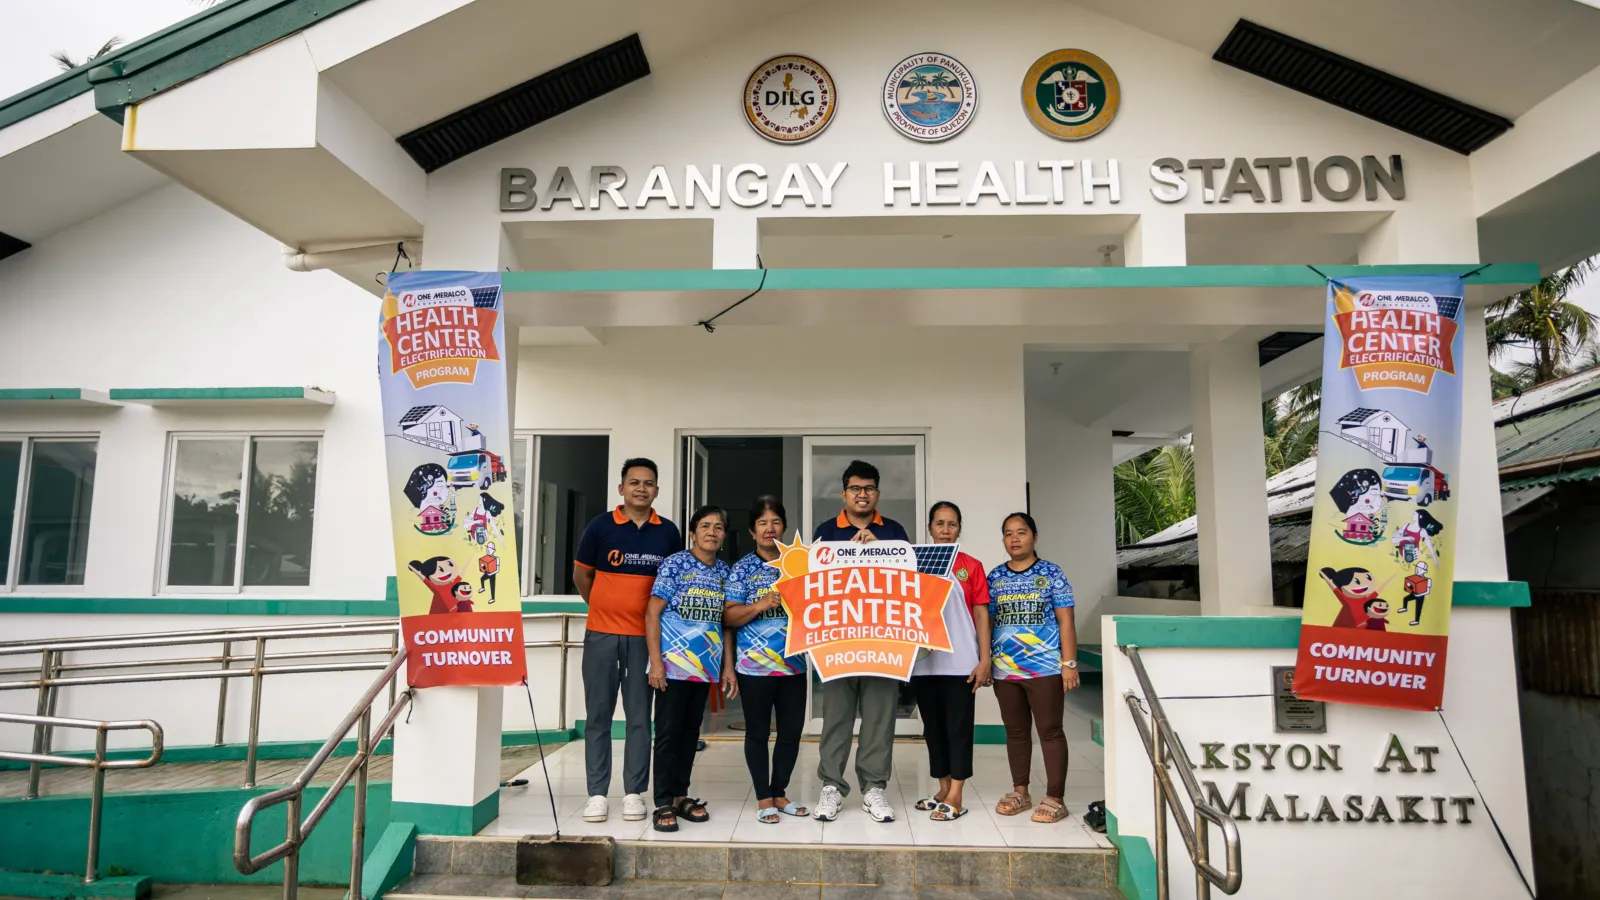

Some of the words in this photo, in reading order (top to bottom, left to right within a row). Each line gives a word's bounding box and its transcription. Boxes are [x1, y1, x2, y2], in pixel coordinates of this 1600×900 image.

[887, 57, 924, 99] MUNICIPALITY
[940, 58, 972, 99] PANUKULAN
[765, 91, 815, 106] DILG
[892, 111, 927, 135] PROVINCE
[928, 128, 939, 136] OF
[940, 109, 969, 133] QUEZON
[499, 162, 849, 212] BARANGAY
[882, 158, 1121, 207] HEALTH
[1148, 154, 1407, 204] STATION
[417, 293, 431, 301] ONE
[433, 290, 467, 299] MERALCO
[1376, 294, 1392, 302] ONE
[1394, 295, 1430, 303] MERALCO
[396, 306, 479, 334] HEALTH
[1350, 310, 1441, 335] HEALTH
[397, 328, 482, 355] CENTER
[1348, 331, 1441, 358] CENTER
[400, 347, 487, 367] ELECTRIFICATION
[1349, 351, 1444, 370] ELECTRIFICATION
[415, 366, 470, 381] PROGRAM
[1363, 370, 1426, 385] PROGRAM
[836, 547, 857, 557] ONE
[859, 547, 907, 556] MERALCO
[804, 568, 921, 600] HEALTH
[803, 598, 924, 630] CENTER
[413, 628, 515, 646] COMMUNITY
[805, 625, 930, 646] ELECTRIFICATION
[422, 650, 513, 667] TURNOVER
[825, 650, 903, 668] PROGRAM
[1309, 642, 1436, 667] COMMUNITY
[1313, 665, 1427, 690] TURNOVER
[1202, 780, 1476, 824] MALASAKIT
